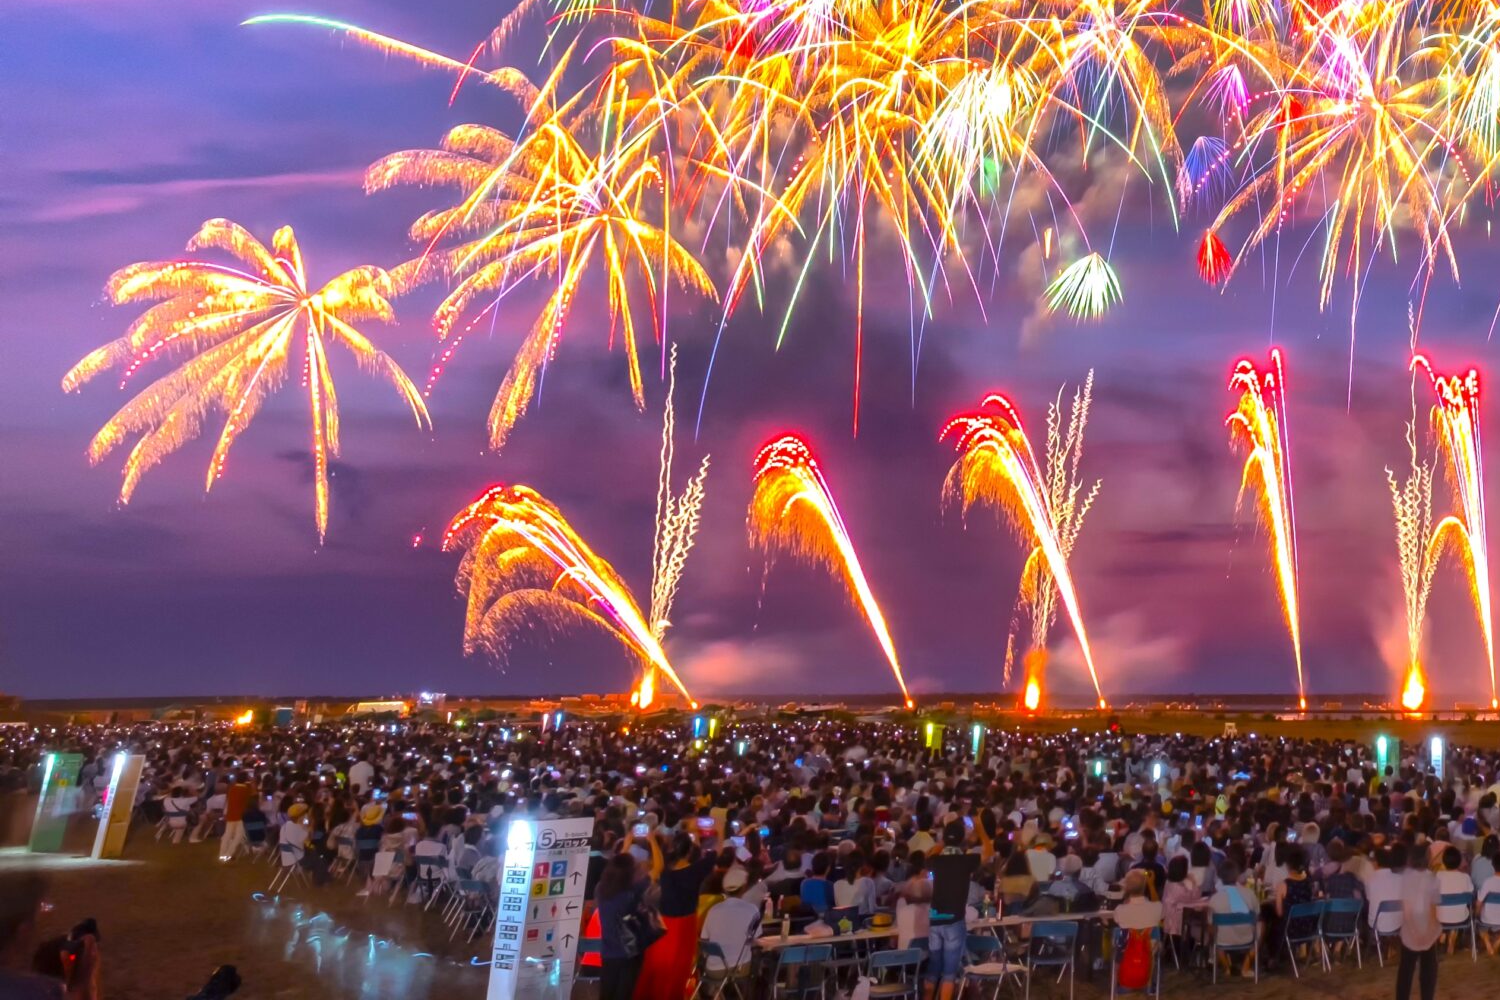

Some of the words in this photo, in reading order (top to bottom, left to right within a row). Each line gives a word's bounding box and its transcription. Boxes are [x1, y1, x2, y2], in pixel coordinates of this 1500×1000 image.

[540, 831, 553, 847] 5
[538, 864, 545, 877] 1
[554, 863, 564, 875] 2
[534, 883, 544, 895] 3
[552, 881, 562, 893] 4
